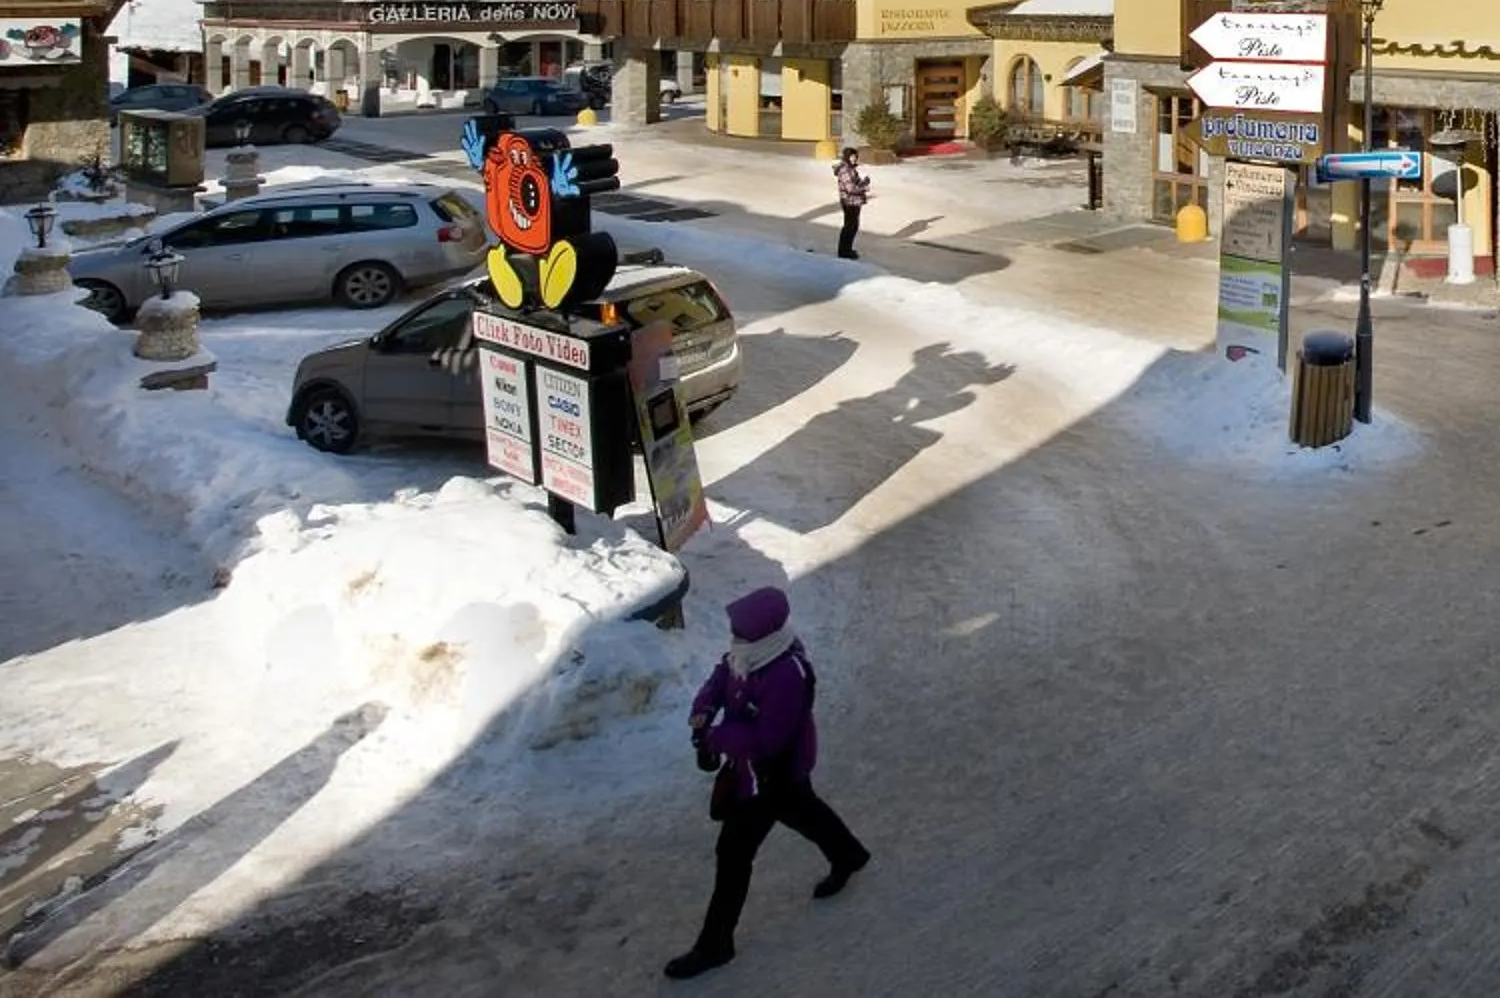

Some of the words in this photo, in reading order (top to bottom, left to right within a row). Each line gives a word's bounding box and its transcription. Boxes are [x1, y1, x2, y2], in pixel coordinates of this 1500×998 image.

[368, 4, 471, 23] GALLERIA
[1238, 37, 1283, 57] Piste
[1235, 85, 1281, 106] Piste
[1202, 113, 1318, 144] profumeria
[477, 315, 509, 343] Click
[513, 325, 543, 353] Foto
[545, 334, 587, 366] Video
[547, 395, 581, 417] CASIO
[494, 415, 523, 435] NOKIA
